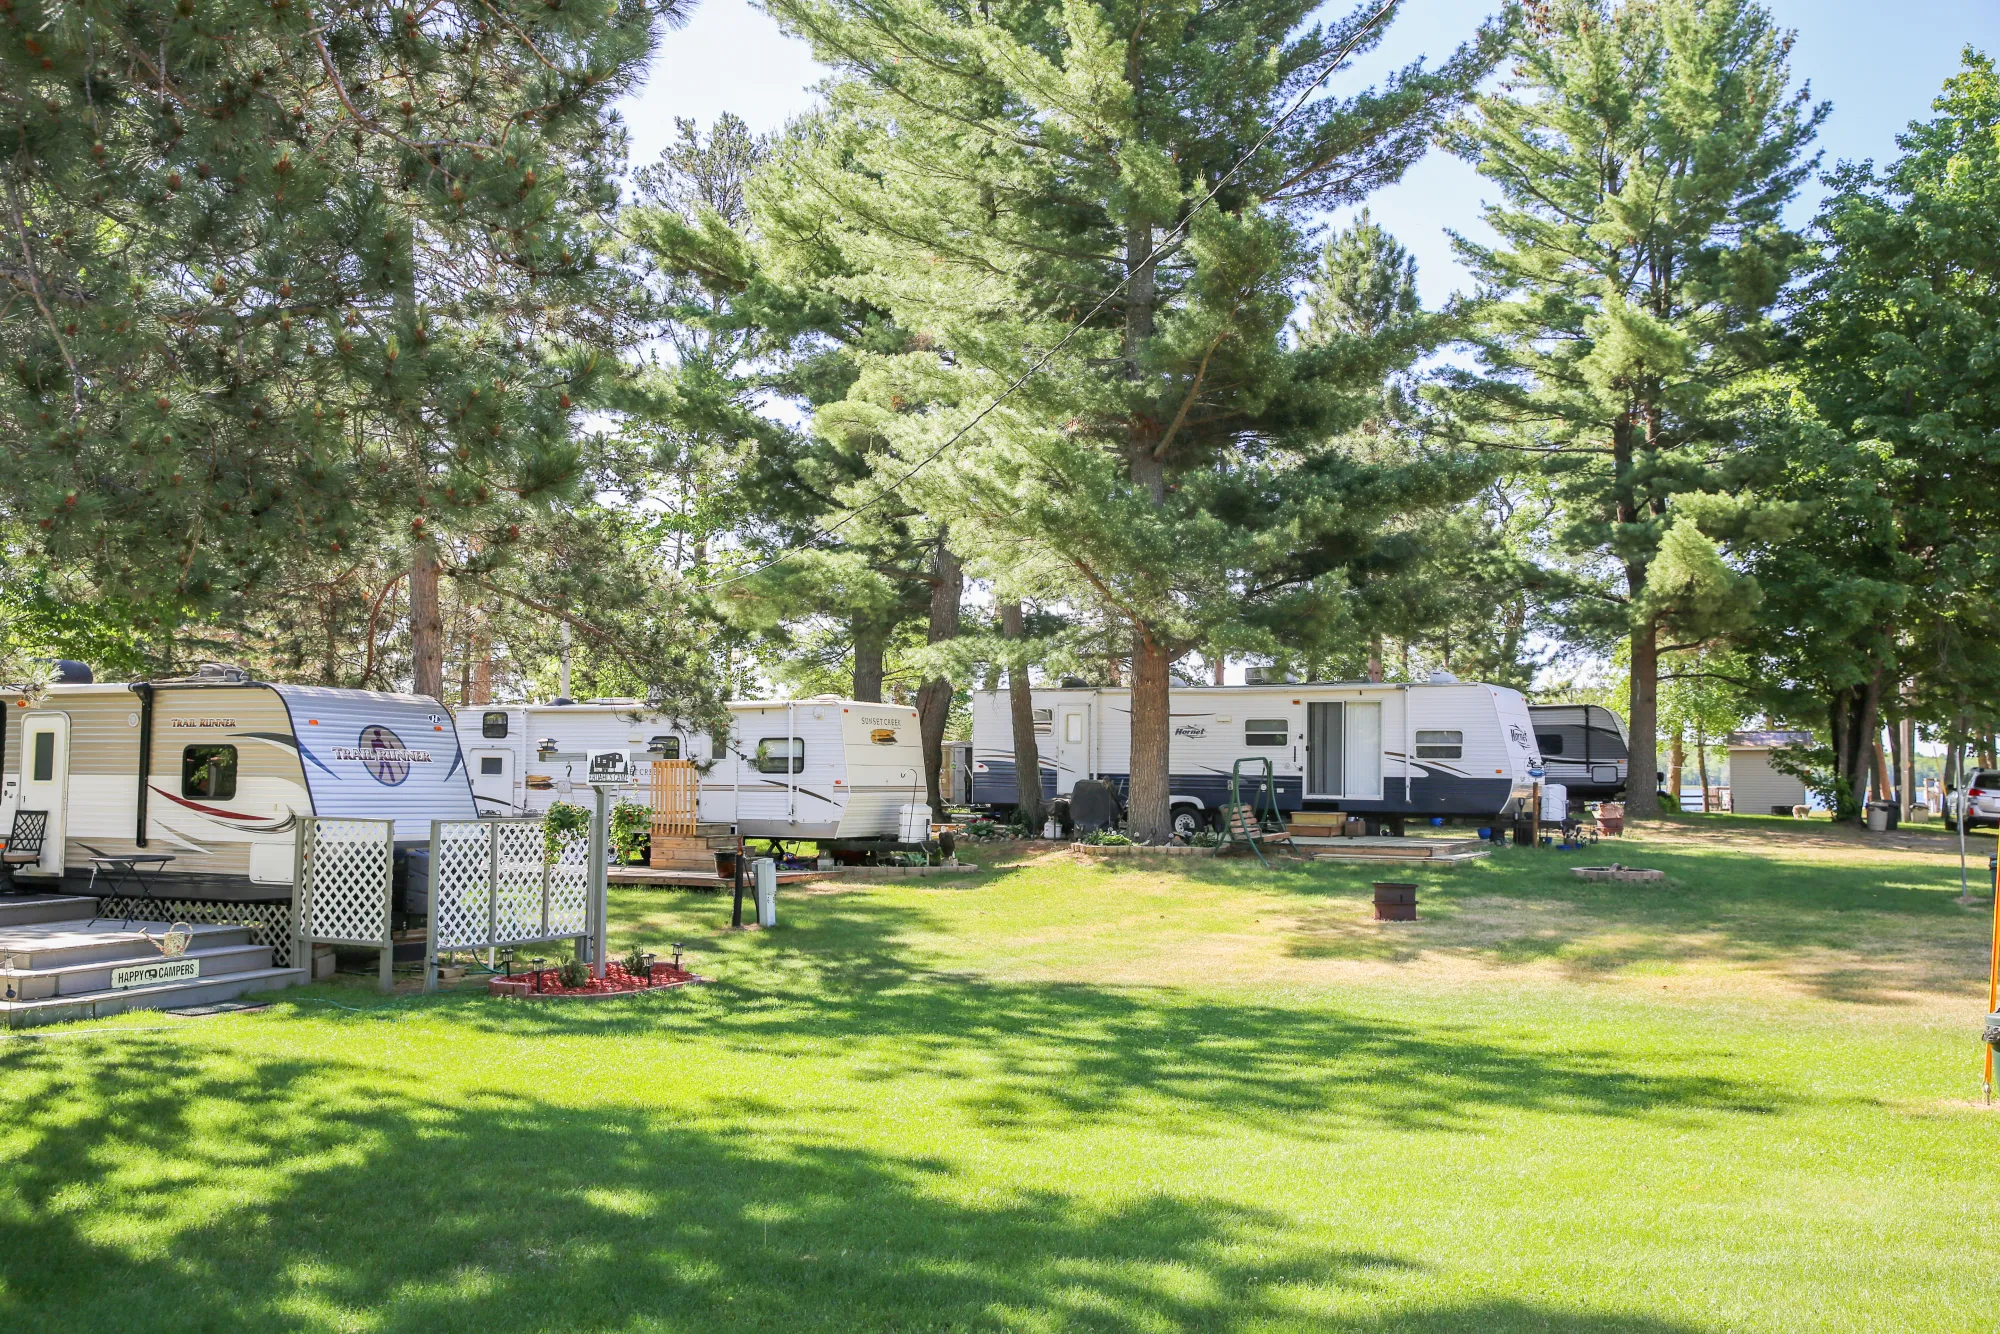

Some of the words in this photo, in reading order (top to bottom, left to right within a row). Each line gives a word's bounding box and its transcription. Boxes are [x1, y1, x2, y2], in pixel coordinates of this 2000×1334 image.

[171, 718, 197, 728] TRAIL
[198, 718, 237, 728] RUNNER
[861, 716, 883, 726] SUNSET
[883, 718, 901, 726] CREEK
[1175, 728, 1205, 736] Hornet
[331, 746, 376, 761] TRAIL
[376, 747, 434, 763] RUNNER
[118, 970, 145, 984] HAPPY
[158, 963, 195, 979] CAMPERS
